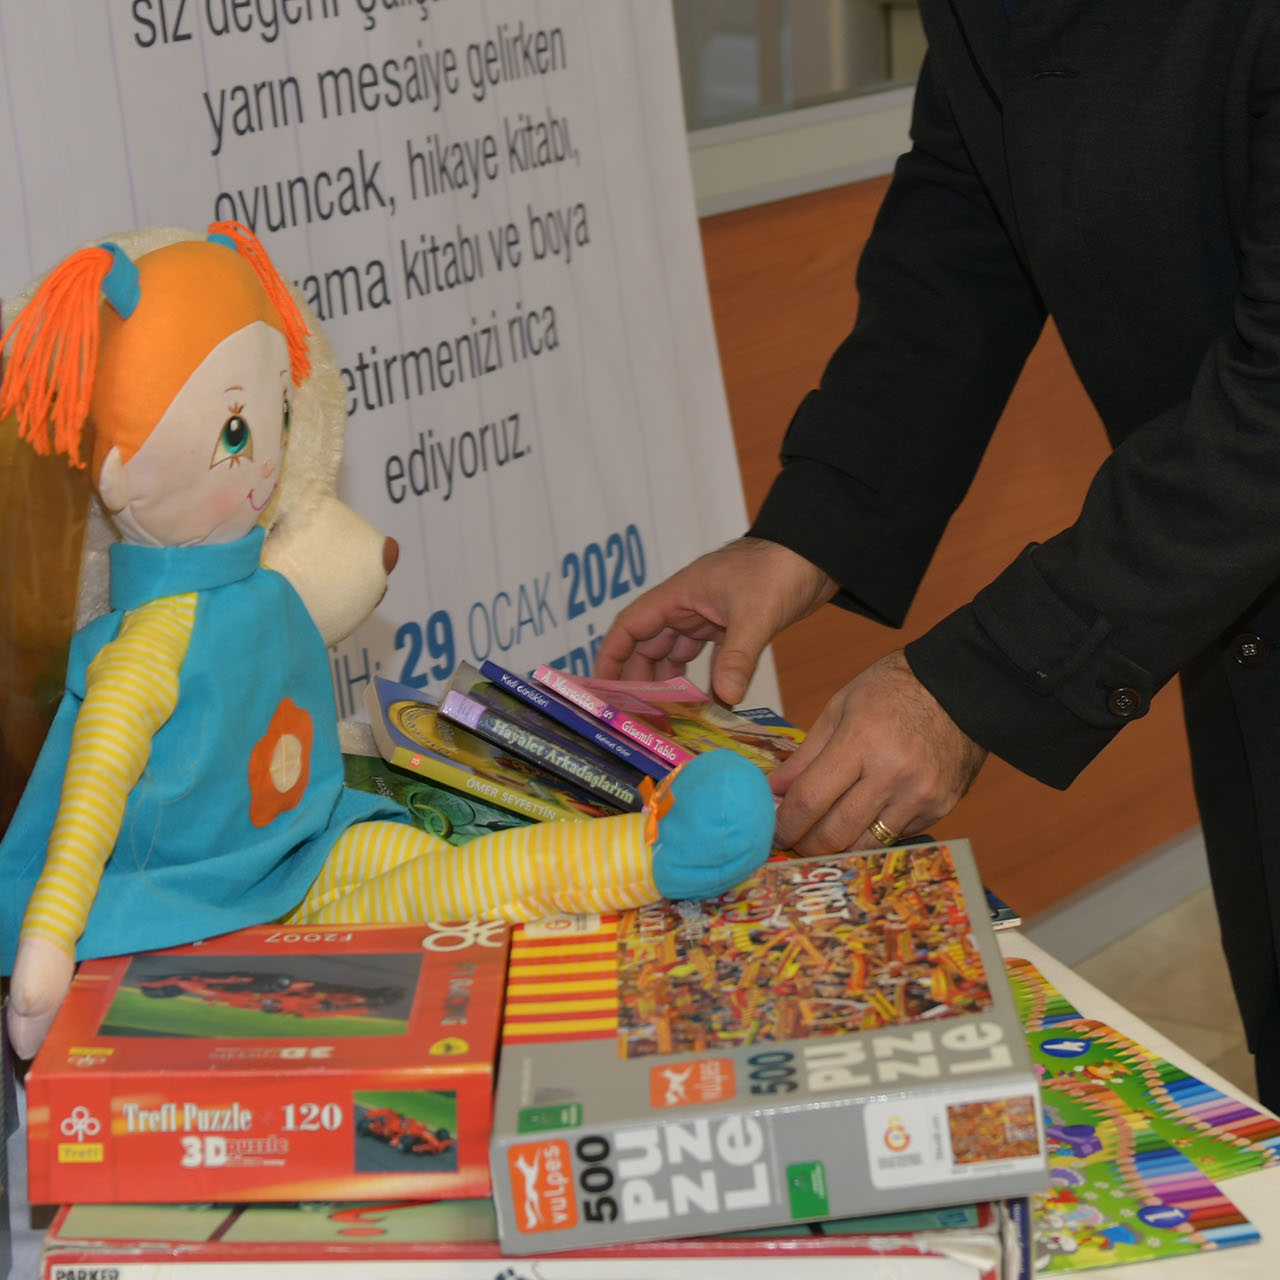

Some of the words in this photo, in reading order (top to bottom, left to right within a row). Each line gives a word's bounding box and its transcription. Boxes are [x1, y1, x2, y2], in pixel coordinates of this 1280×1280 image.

[203, 73, 305, 157] yarın
[318, 38, 459, 120] mesaiye
[466, 21, 568, 104] gelirken
[406, 133, 499, 200] hikaye
[505, 107, 581, 176] kitabı,
[294, 261, 391, 322] ama
[400, 224, 484, 301] kitabı
[488, 218, 521, 274] ve
[526, 201, 591, 265] boya
[340, 310, 504, 417] etirmenizi
[507, 300, 560, 365] rica
[384, 412, 532, 505] ediyoruz.
[394, 609, 457, 691] 29
[467, 572, 558, 663] OCAK
[561, 523, 647, 621] 2020
[491, 718, 545, 757] Hayalet
[544, 747, 636, 805] Arkadaşlarım
[621, 720, 653, 748] Gizemli
[652, 739, 678, 762] Tablo
[465, 776, 499, 798] ÖMER
[264, 932, 354, 944] F2007
[123, 1102, 178, 1133] Trefl
[183, 1102, 254, 1133] Puzzle
[280, 1103, 344, 1132] 120
[746, 1051, 798, 1097] 500
[180, 1135, 228, 1168] 3D
[576, 1134, 618, 1224] 500
